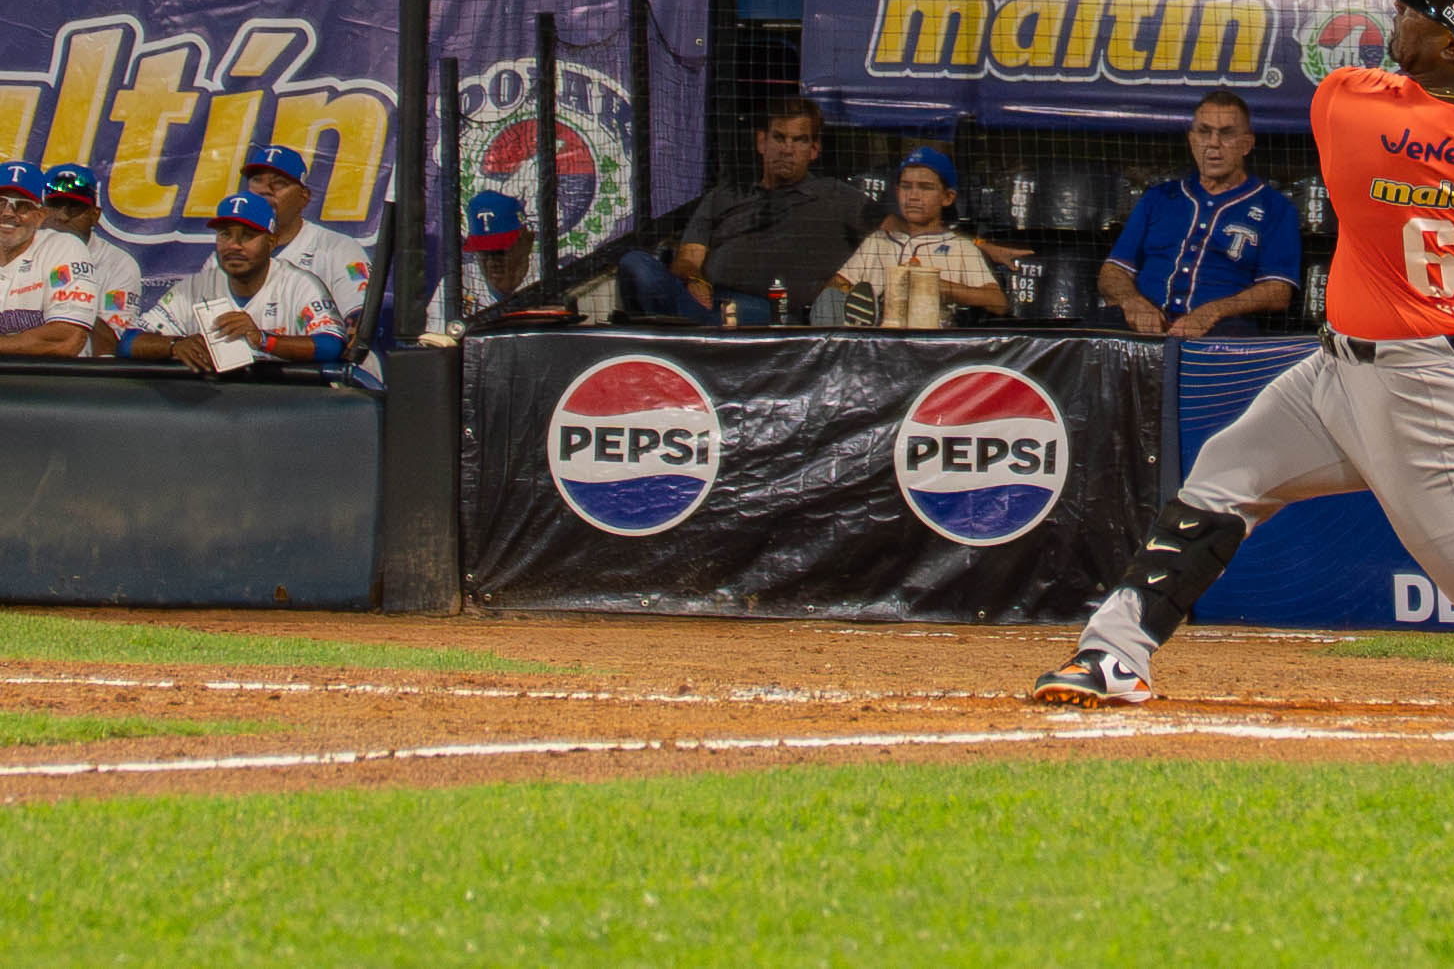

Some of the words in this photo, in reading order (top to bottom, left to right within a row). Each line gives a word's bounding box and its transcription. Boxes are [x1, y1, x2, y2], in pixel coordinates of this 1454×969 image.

[0, 28, 389, 221] ltín
[264, 148, 283, 163] T
[8, 166, 27, 183] T
[863, 178, 885, 191] TE1
[1013, 181, 1035, 193] TE1
[229, 197, 248, 214] T
[477, 211, 495, 232] T
[1221, 224, 1258, 262] T
[1020, 264, 1042, 278] TE1
[1019, 278, 1034, 290] 02
[1018, 290, 1034, 303] 03
[559, 425, 710, 466] PEPSI
[907, 436, 1057, 476] PEPSI
